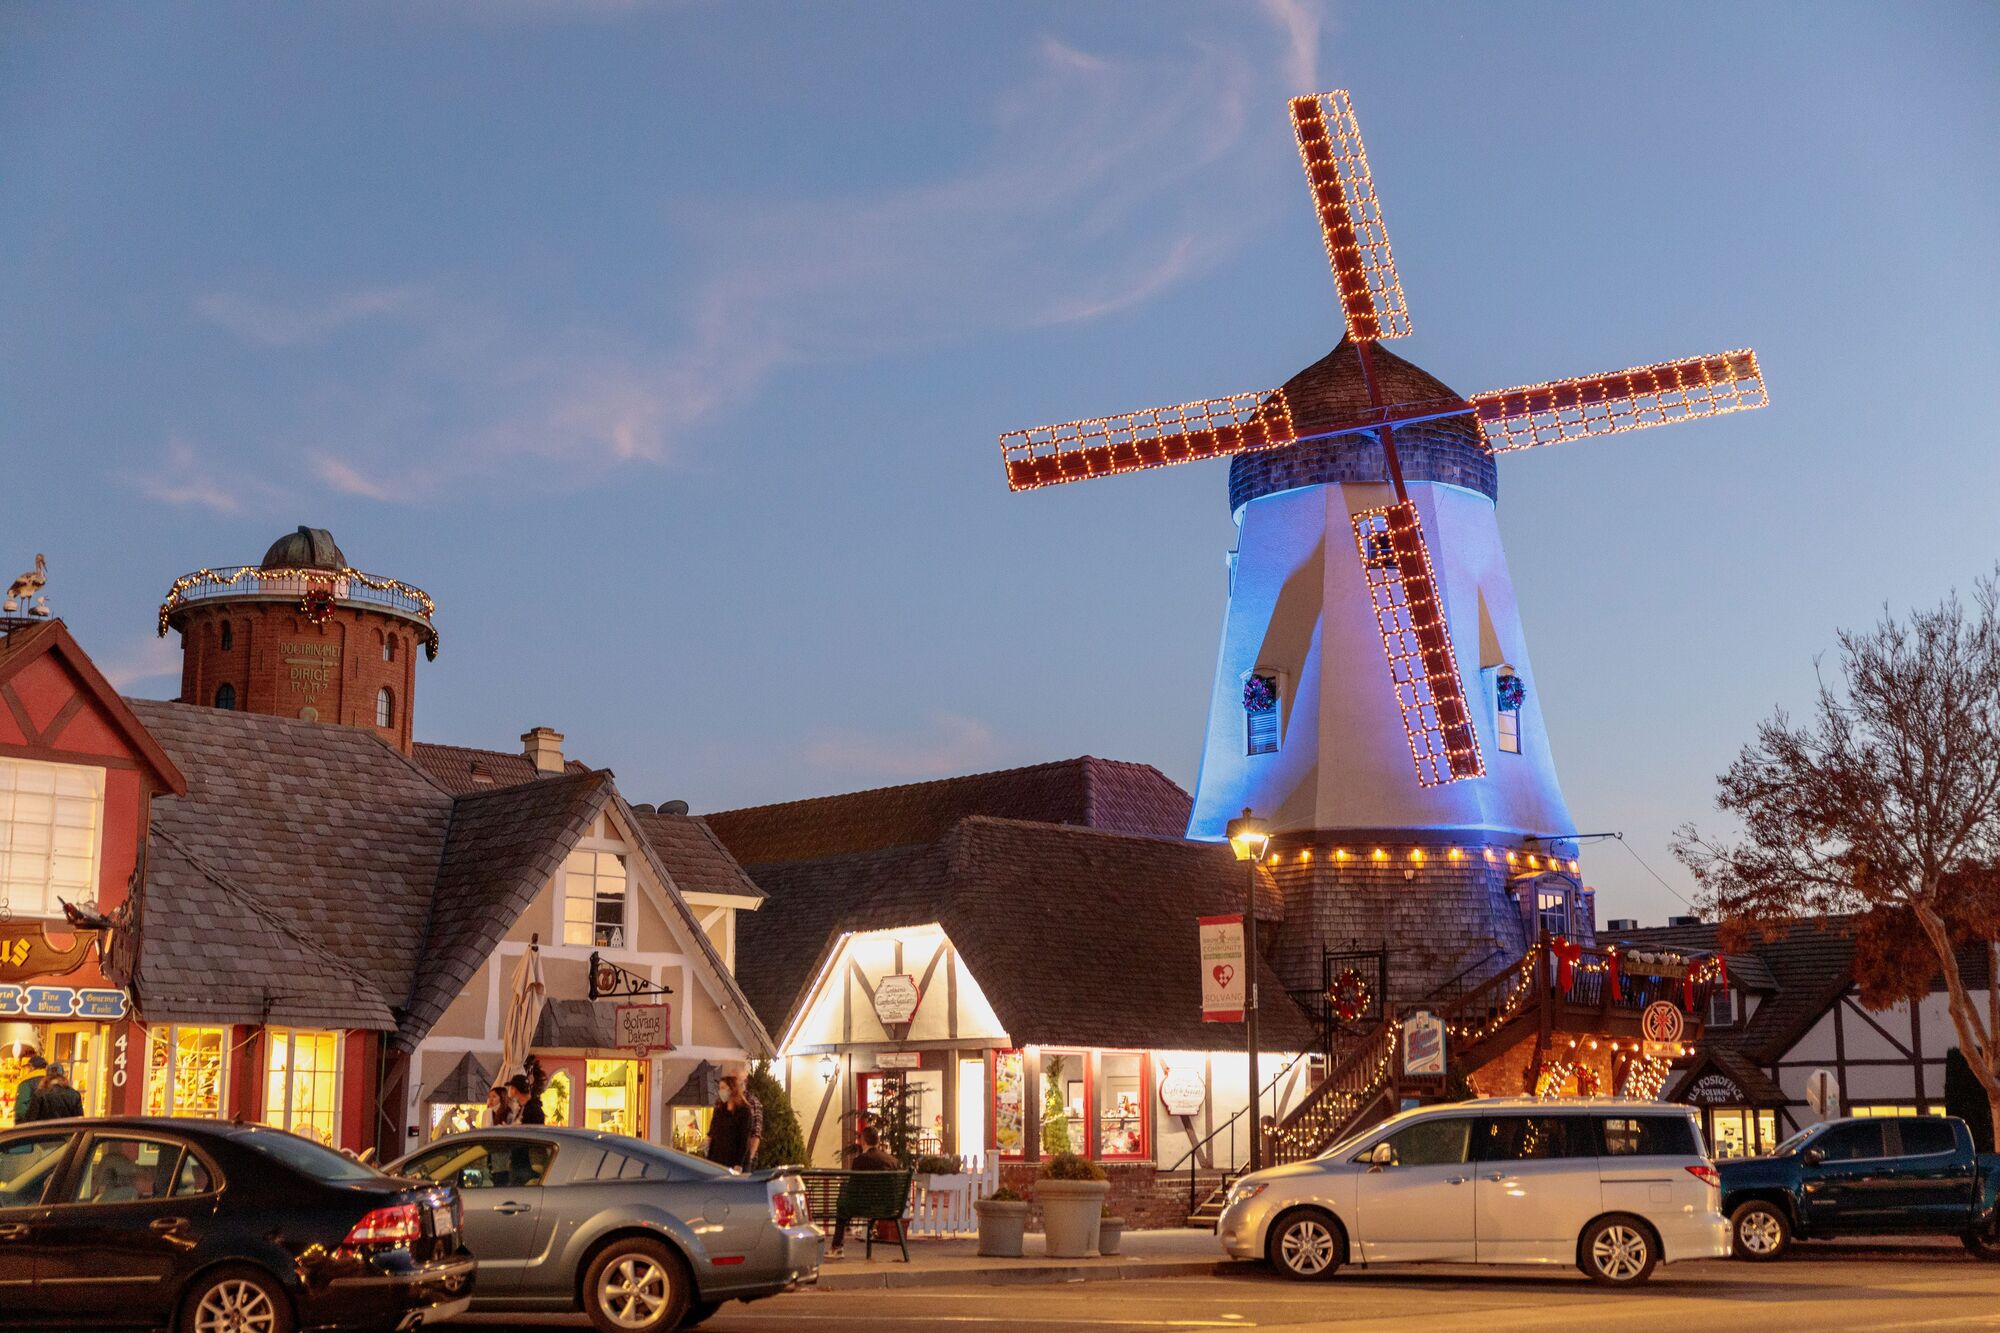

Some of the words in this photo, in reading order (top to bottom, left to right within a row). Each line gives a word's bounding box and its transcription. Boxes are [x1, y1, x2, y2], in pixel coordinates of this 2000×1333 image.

[1203, 945, 1241, 953] COMMUNITY
[42, 991, 59, 1001] Fine
[86, 994, 117, 1003] Gourmet
[1205, 992, 1243, 1002] SOLVANG
[38, 1001, 61, 1012] Wines
[624, 1012, 660, 1032] Solvang
[627, 1029, 655, 1045] Bakery
[113, 1034, 127, 1087] 440
[1700, 1088, 1731, 1098] SOLVANG
